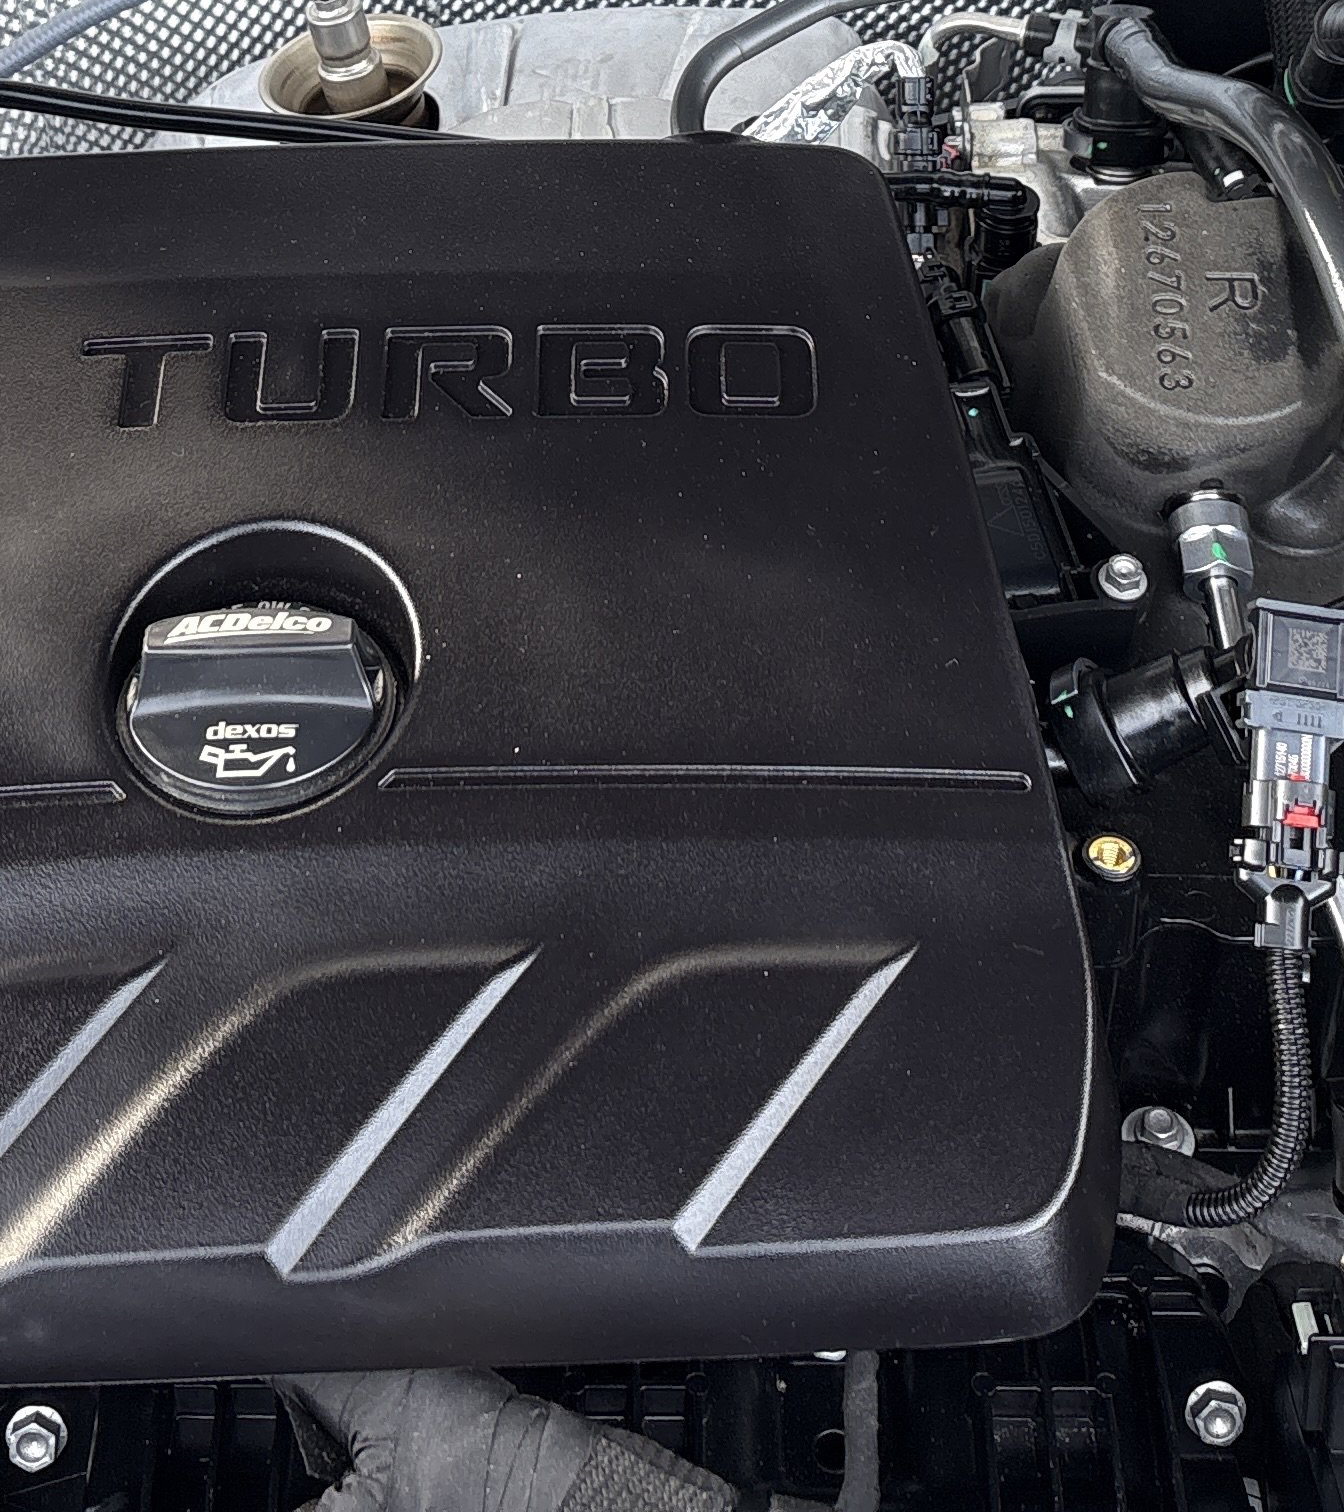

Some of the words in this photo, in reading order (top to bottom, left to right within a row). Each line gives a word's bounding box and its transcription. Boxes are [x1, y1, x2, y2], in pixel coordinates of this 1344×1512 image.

[1137, 201, 1195, 393] 12670563
[1205, 270, 1264, 313] R
[81, 324, 819, 429] TURBO
[167, 610, 333, 638] ACDelco
[205, 721, 298, 740] dexos
